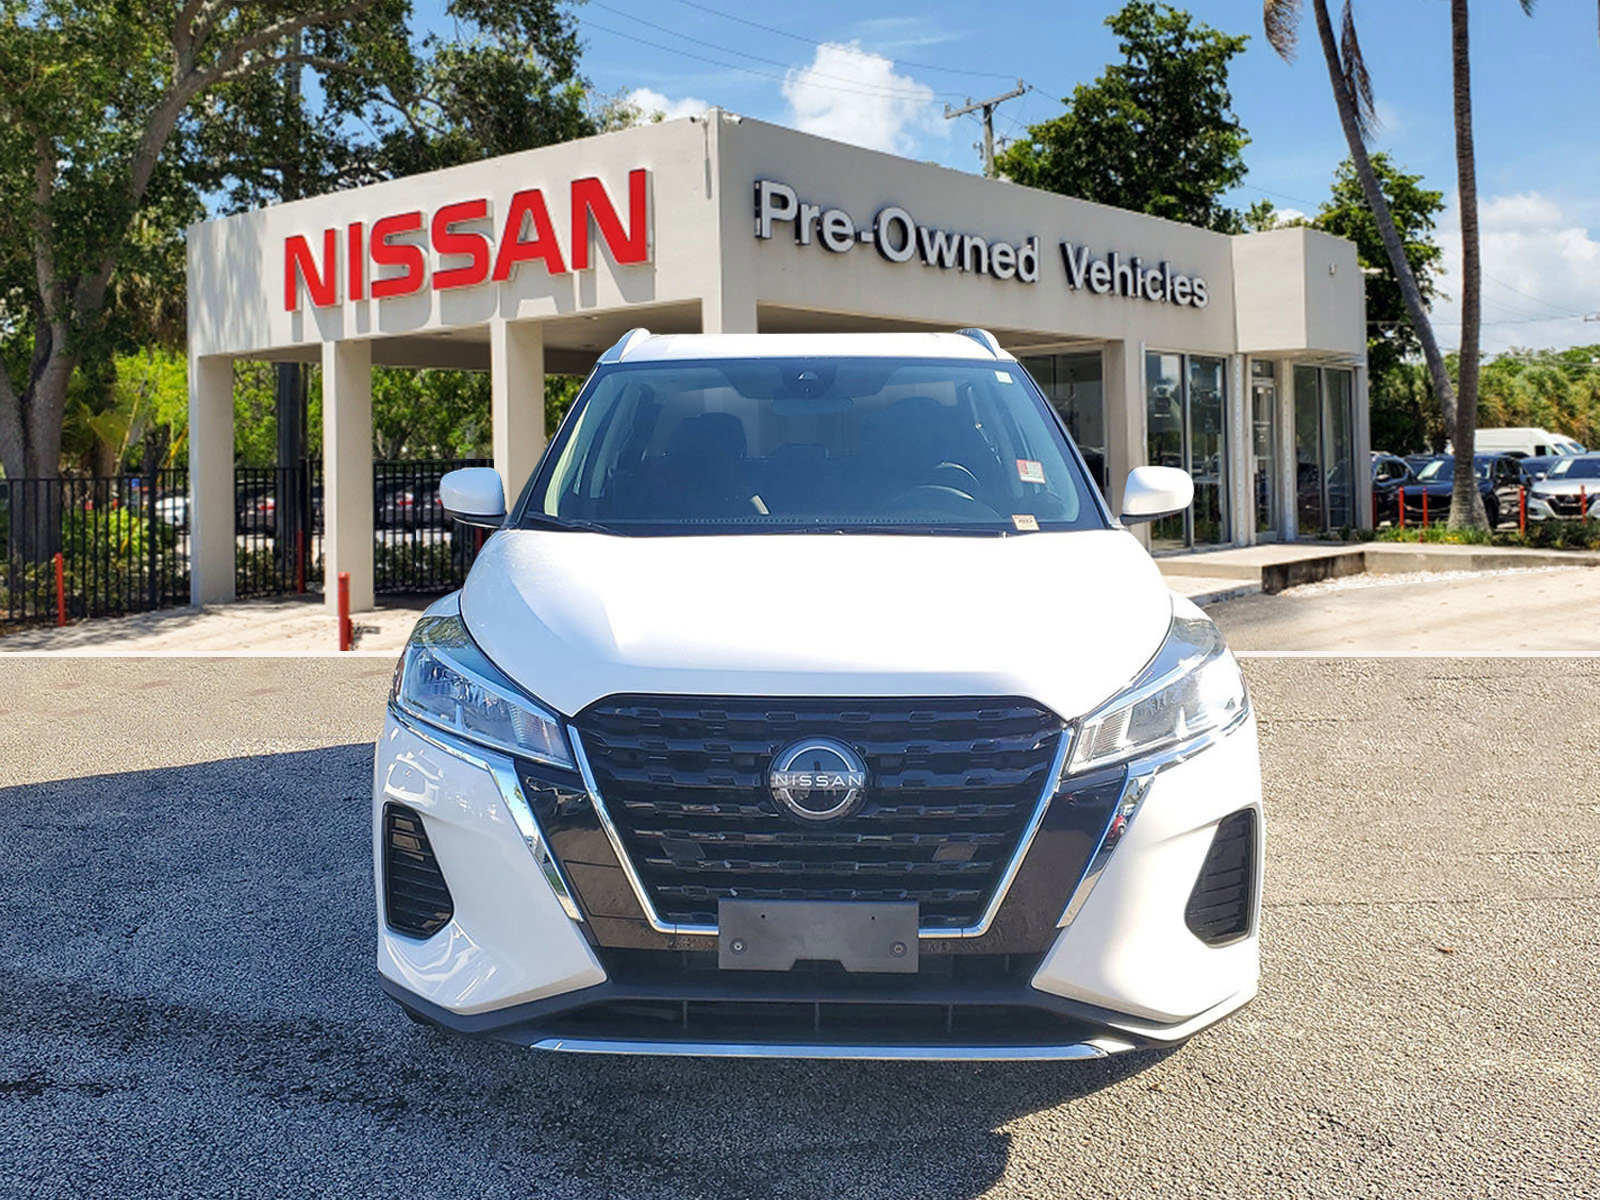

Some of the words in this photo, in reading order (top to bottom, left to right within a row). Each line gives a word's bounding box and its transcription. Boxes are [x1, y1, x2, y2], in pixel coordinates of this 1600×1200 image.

[284, 168, 648, 312] NISSAN
[753, 179, 1040, 284] Pre-Owned
[1060, 241, 1209, 309] Vehicles
[774, 774, 863, 787] NISSAN
